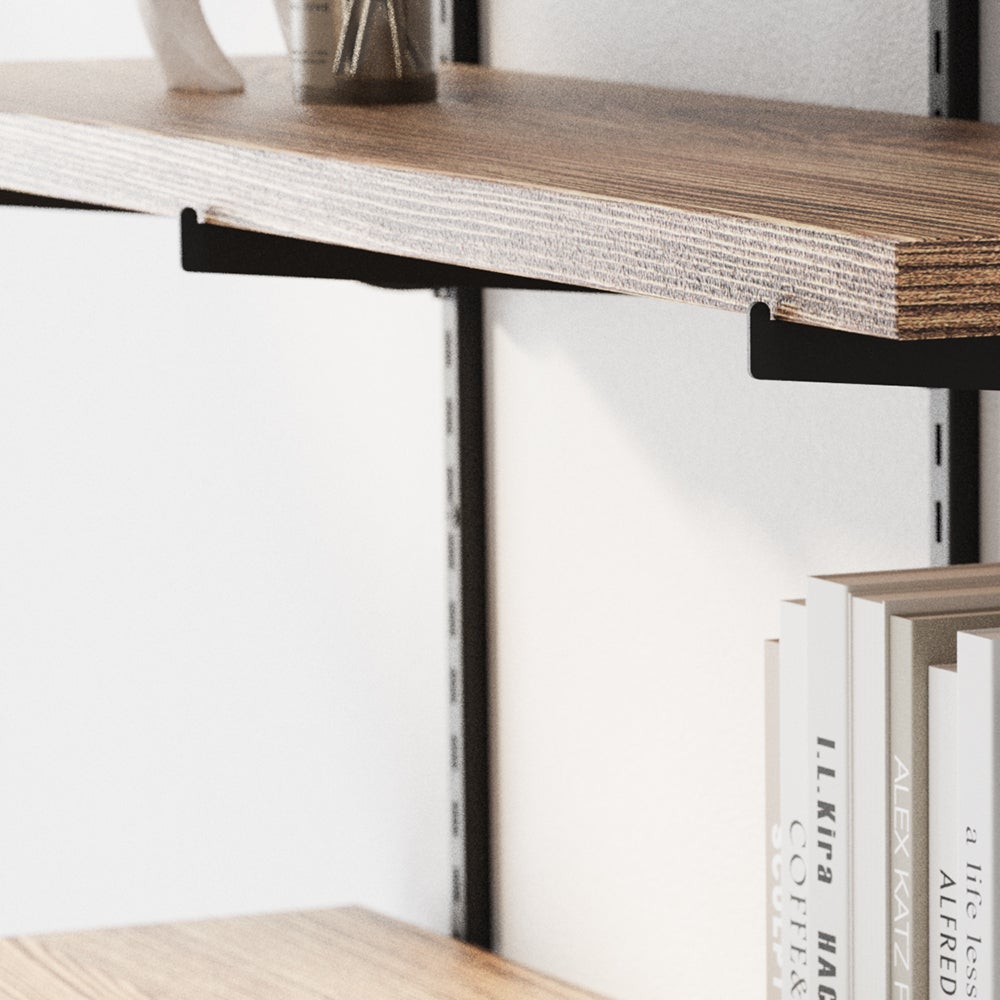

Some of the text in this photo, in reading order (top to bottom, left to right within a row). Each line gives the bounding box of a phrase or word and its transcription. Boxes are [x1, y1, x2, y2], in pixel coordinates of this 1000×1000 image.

[893, 754, 910, 858] ALEX
[965, 825, 978, 845] a
[893, 868, 910, 971] KATZ
[965, 861, 983, 920] life
[939, 869, 957, 997] ALFRED
[965, 933, 983, 999] less
